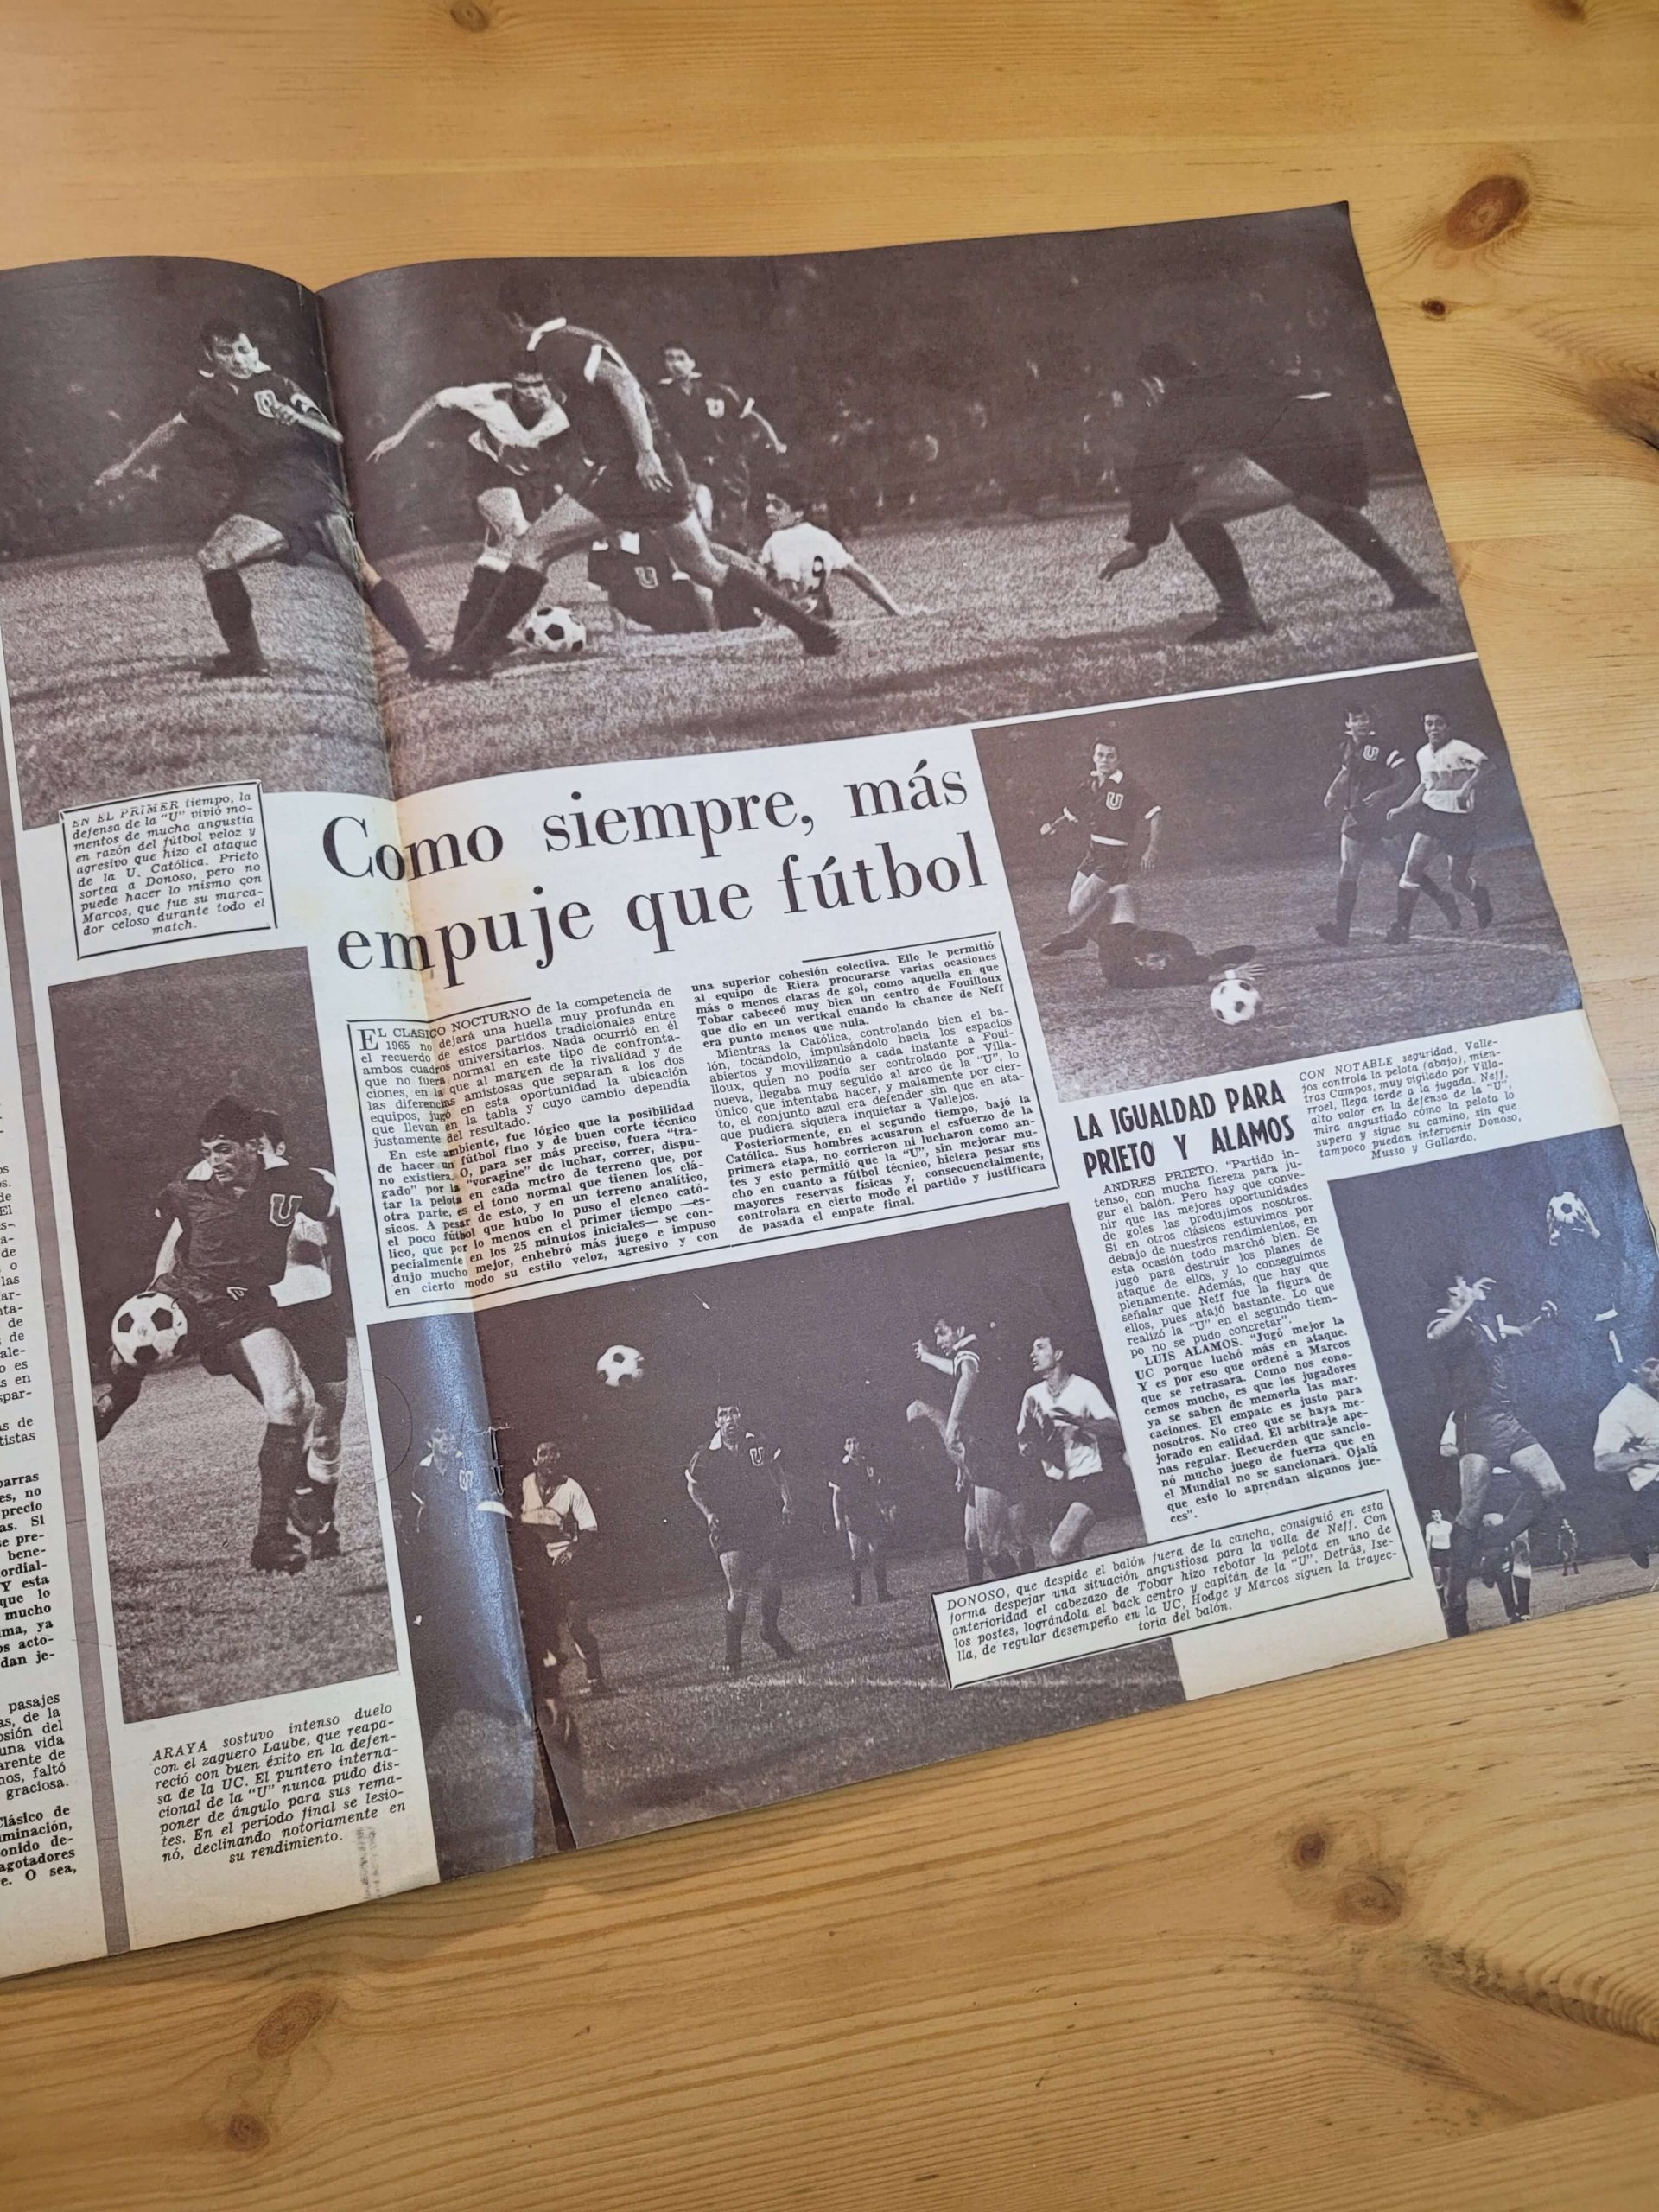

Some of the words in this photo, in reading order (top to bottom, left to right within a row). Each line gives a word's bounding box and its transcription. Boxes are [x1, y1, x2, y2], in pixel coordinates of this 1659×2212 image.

[634, 567, 658, 589] U
[1363, 745, 1379, 761] U
[321, 813, 505, 883] Como
[543, 790, 817, 859] siempre,
[844, 759, 969, 819] más
[1106, 791, 1123, 810] U
[73, 836, 119, 850] mentos
[124, 831, 139, 841] de
[147, 823, 190, 837] mucha
[198, 815, 253, 830] angustia
[75, 854, 90, 862] en
[96, 844, 130, 858] razón
[137, 839, 156, 851] del
[163, 832, 201, 849] fútbol
[209, 828, 241, 840] veloz
[249, 828, 255, 836] y
[76, 858, 128, 874] agresivo
[134, 853, 156, 865] que
[162, 848, 188, 858] hizo
[196, 843, 207, 853] el
[213, 839, 257, 851] ataque
[78, 877, 92, 887] de
[104, 873, 115, 882] la
[126, 867, 140, 877] U.
[150, 858, 208, 873] Católica.
[219, 851, 258, 862] Prieto
[338, 886, 594, 989] empuje
[626, 882, 753, 954] que
[777, 830, 988, 916] fútbol
[722, 975, 770, 988] superior
[779, 966, 828, 982] cohesión
[836, 959, 889, 972] colectiva.
[897, 953, 919, 963] Ello
[946, 941, 994, 957] permitió
[1299, 1068, 1324, 1081] CON
[1335, 1057, 1392, 1075] NOTABLE
[1402, 1045, 1457, 1062] seguridad,
[1465, 1039, 1497, 1050] Valle-
[1073, 1113, 1103, 1141] LA
[1110, 1092, 1216, 1135] IGUALDAD
[1224, 1079, 1286, 1113] PARA
[1082, 1141, 1155, 1178] PRIETO
[1173, 1134, 1187, 1160] Y
[1211, 1114, 1294, 1154] ALAMOS
[1319, 1143, 1365, 1158] tampoco
[1371, 1134, 1412, 1149] puedan
[1418, 1122, 1471, 1139] intervenir
[1478, 1114, 1521, 1128] Donoso,
[1371, 1147, 1405, 1160] Musso
[1412, 1145, 1417, 1154] y
[1425, 1133, 1476, 1148] Gallardo.
[1103, 1175, 1156, 1193] ANDRES
[1164, 1165, 1217, 1181] PRIETO.
[1281, 1149, 1299, 1159] in-
[270, 1193, 302, 1227] U
[739, 1224, 753, 1234] de
[762, 1216, 804, 1231] pasada
[812, 1211, 823, 1221] el
[832, 1204, 874, 1217] empate
[884, 1196, 914, 1209] final.
[422, 1281, 454, 1292] cierto
[464, 1274, 494, 1287] modo
[504, 1269, 518, 1279] su
[528, 1260, 561, 1274] estilo
[572, 1252, 607, 1264] veloz,
[617, 1241, 668, 1256] agresivo
[679, 1237, 685, 1247] y
[696, 1232, 718, 1242] con
[1124, 1322, 1154, 1333] ellos,
[1160, 1314, 1187, 1327] pues
[1195, 1305, 1224, 1323] atajó
[1232, 1294, 1285, 1310] bastante.
[1291, 1288, 1306, 1298] Lo
[1314, 1283, 1334, 1294] que
[750, 1446, 765, 1466] U
[947, 1587, 1009, 1610] DONOSO,
[1016, 1583, 1037, 1596] que
[1044, 1569, 1088, 1587] despide
[1095, 1564, 1105, 1575] el
[1112, 1556, 1145, 1575] balón
[1153, 1548, 1188, 1564] fuera
[1190, 1542, 1204, 1553] de
[1210, 1538, 1222, 1548] la
[1229, 1528, 1274, 1544] cancha,
[1280, 1510, 1333, 1532] consiguió
[1340, 1510, 1354, 1518] en
[1361, 1502, 1383, 1513] esta
[1138, 1617, 1166, 1630] toria
[1173, 1609, 1190, 1623] del
[1195, 1602, 1231, 1617] balón.
[8, 1694, 60, 1714] pasajes
[152, 1740, 207, 1761] ARAYA
[222, 1729, 273, 1748] sostuvo
[289, 1716, 340, 1734] intenso
[354, 1703, 391, 1719] duelo
[154, 1763, 180, 1777] con
[184, 1757, 196, 1775] el
[202, 1747, 256, 1766] zaguero
[263, 1737, 309, 1755] Laube,
[316, 1730, 340, 1745] que
[347, 1719, 393, 1736] reapa-
[155, 1772, 188, 1789] reció
[195, 1770, 219, 1782] con
[226, 1761, 259, 1775] buen
[266, 1752, 301, 1767] éxito
[307, 1748, 324, 1758] en
[330, 1743, 344, 1758] la
[349, 1733, 395, 1750] defen-
[157, 1793, 172, 1808] sa
[178, 1787, 194, 1800] de
[200, 1783, 214, 1795] la
[222, 1776, 248, 1790] UC.
[255, 1770, 269, 1784] El
[276, 1761, 332, 1782] puntero
[339, 1748, 397, 1766] interna-
[6, 1779, 68, 1800] graciosa.
[158, 1799, 200, 1818] cional
[207, 1796, 223, 1808] de
[229, 1792, 243, 1808] la
[282, 1777, 326, 1793] nunca
[332, 1766, 366, 1785] pudo
[373, 1760, 399, 1773] dis-
[160, 1817, 200, 1835] poner
[207, 1810, 224, 1823] de
[232, 1798, 279, 1818] ángulo
[287, 1792, 320, 1809] para
[328, 1786, 350, 1798] sus
[359, 1776, 401, 1790] rema-
[162, 1835, 185, 1847] tes.
[193, 1828, 213, 1840] En
[221, 1821, 233, 1834] el
[302, 1801, 335, 1821] final
[343, 1799, 357, 1809] se
[366, 1789, 403, 1804] lesio-
[162, 1847, 184, 1862] nó,
[194, 1830, 270, 1855] declinando
[282, 1808, 378, 1842] notoriamente
[390, 1802, 405, 1813] en
[229, 1852, 245, 1863] su
[251, 1832, 342, 1859] rendimiento.
